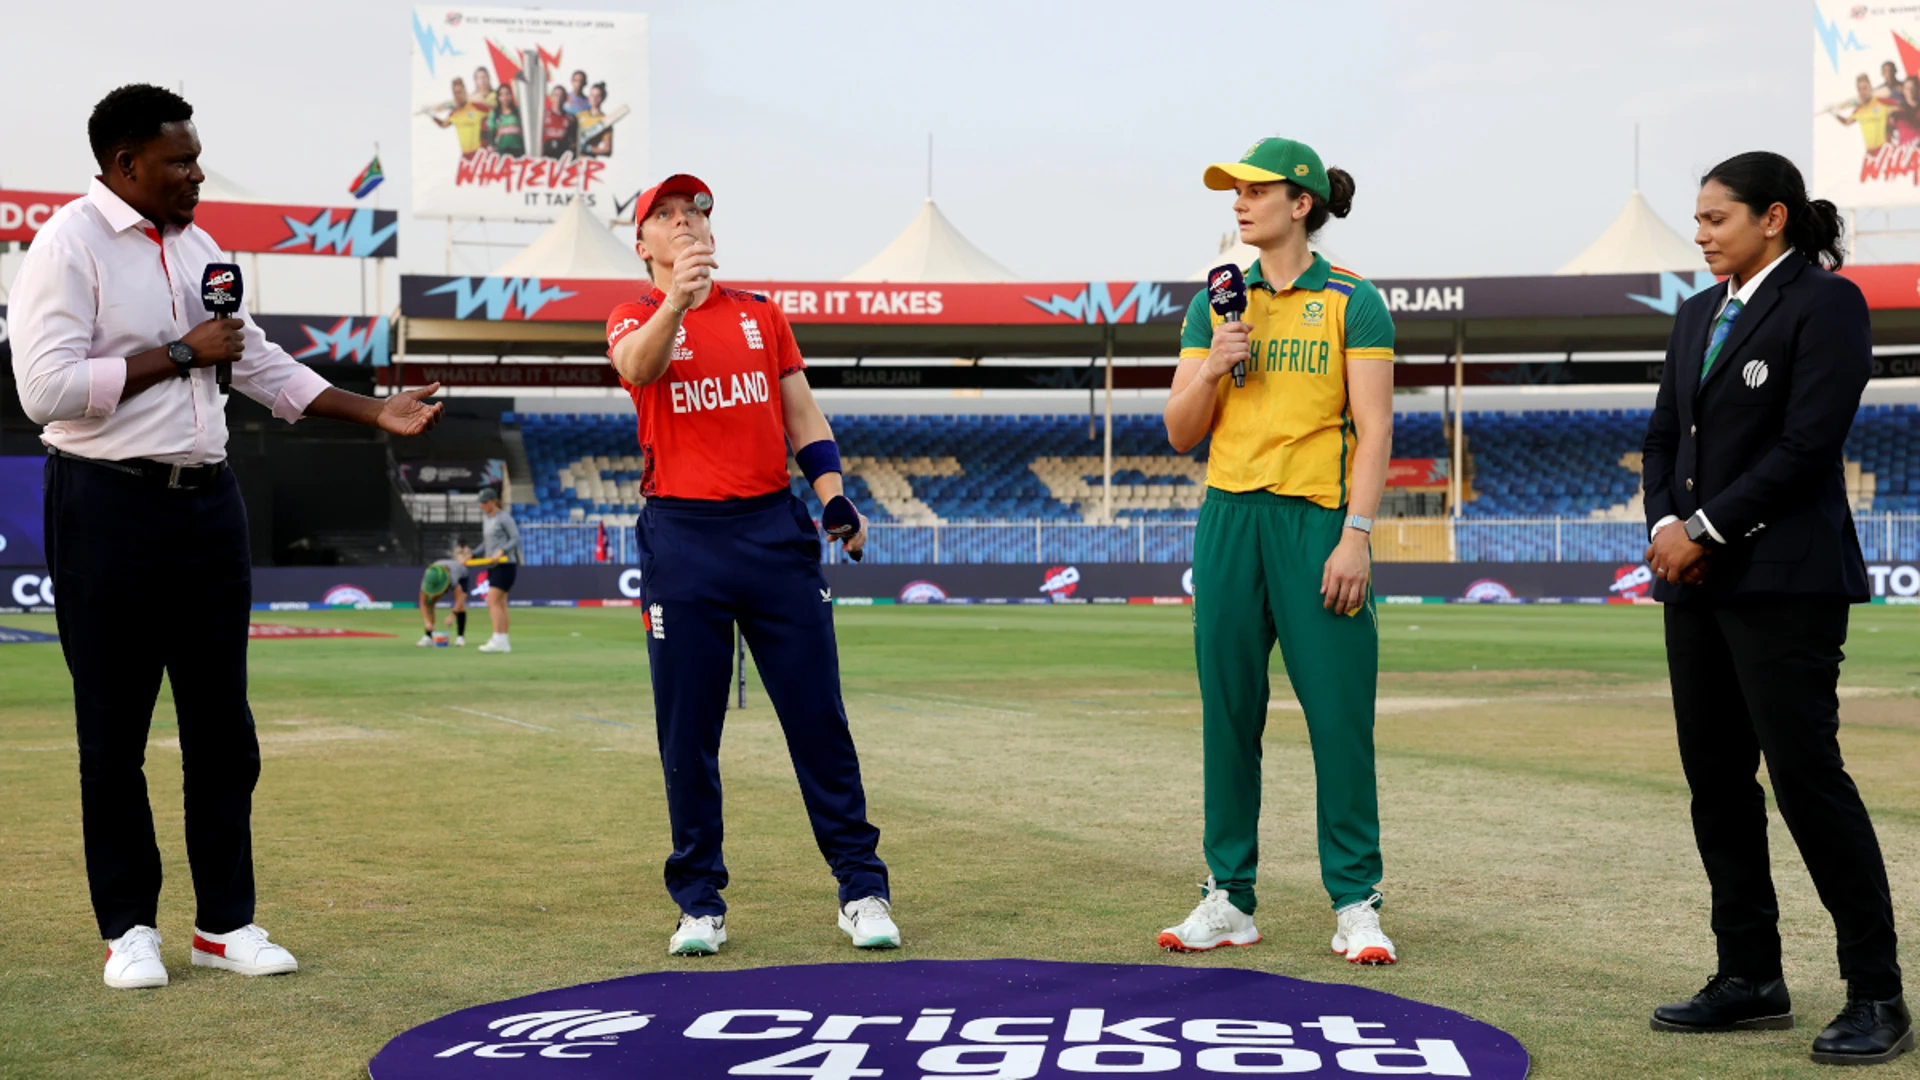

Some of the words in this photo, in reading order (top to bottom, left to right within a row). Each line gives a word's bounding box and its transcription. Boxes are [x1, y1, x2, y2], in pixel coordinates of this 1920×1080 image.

[456, 152, 606, 193] WHATEVER
[524, 193, 539, 206] IT
[0, 203, 60, 230] DC
[825, 291, 849, 314] IT
[856, 291, 943, 314] TAKES
[1380, 286, 1464, 311] ARJAH
[1266, 339, 1329, 375] AFRICA
[422, 367, 522, 383] WHATEVER
[527, 368, 543, 382] IT
[546, 368, 602, 383] TAKES
[841, 370, 921, 385] SHARJAH
[670, 371, 769, 414] ENGLAND
[682, 1008, 1396, 1045] Cricket
[434, 1040, 618, 1058] ICC
[727, 1039, 1471, 1080] 4good
